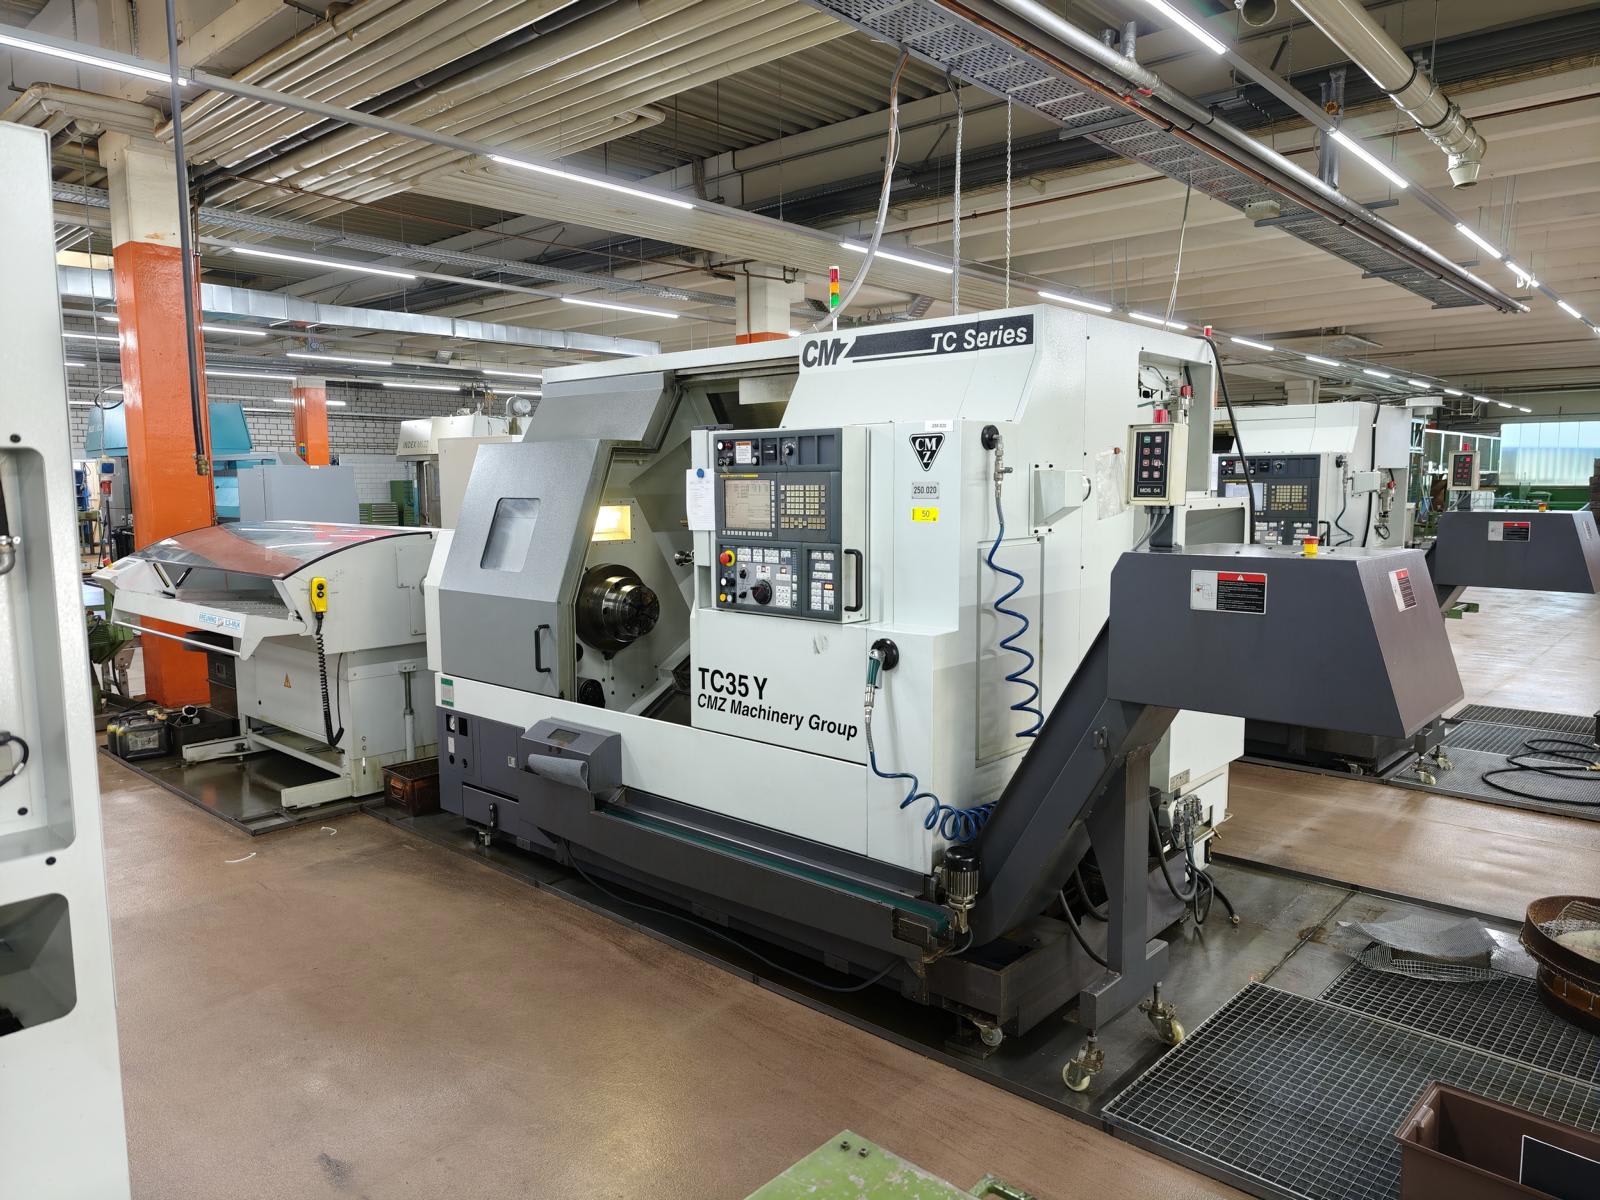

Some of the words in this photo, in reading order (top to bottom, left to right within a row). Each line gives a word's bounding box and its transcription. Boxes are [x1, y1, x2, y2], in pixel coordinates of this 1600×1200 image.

[930, 331, 957, 352] TC
[963, 325, 1027, 350] Series
[403, 440, 418, 448] INDEX
[913, 486, 937, 494] 250.020
[921, 510, 930, 518] 50
[697, 693, 728, 712] CMZ
[729, 699, 805, 731] Machinery
[808, 714, 858, 741] Group
